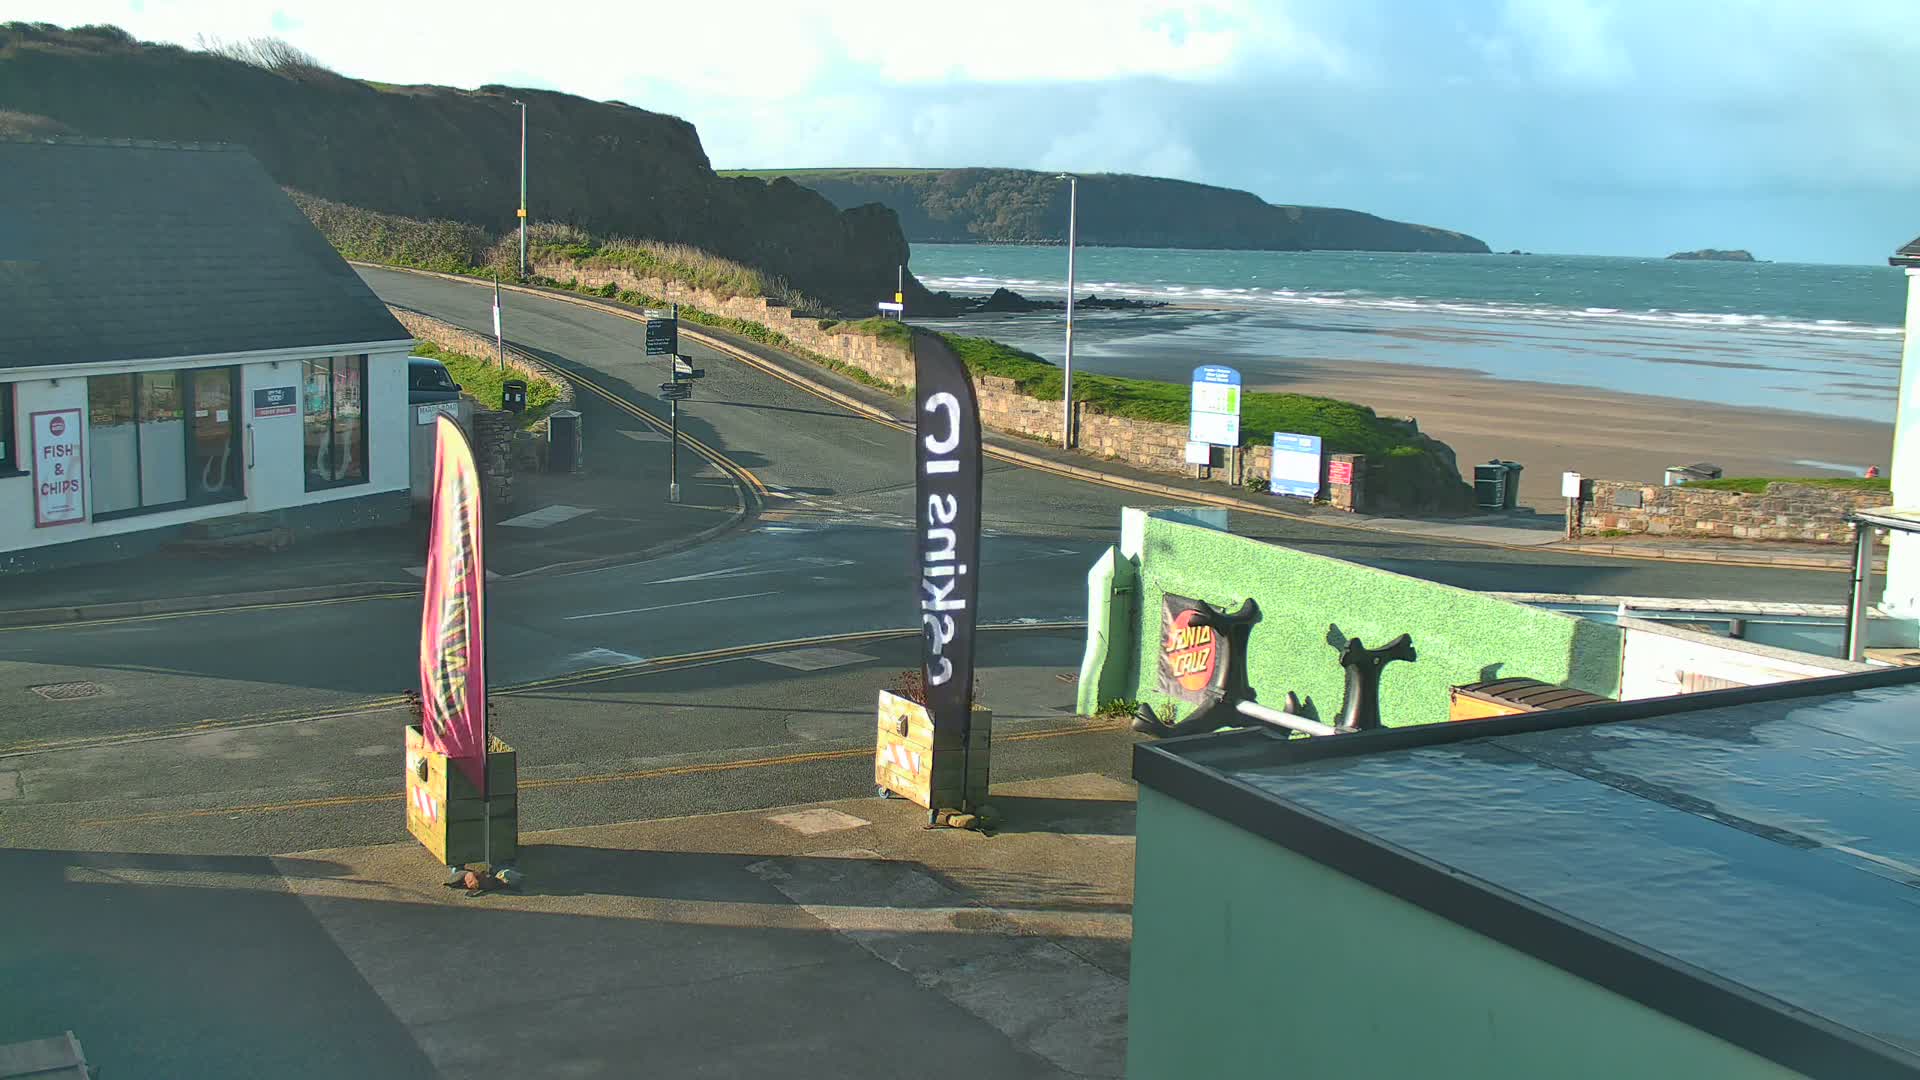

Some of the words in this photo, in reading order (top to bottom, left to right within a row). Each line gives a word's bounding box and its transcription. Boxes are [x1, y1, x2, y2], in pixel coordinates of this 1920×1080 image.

[43, 444, 74, 459] FISH
[54, 462, 65, 476] &
[41, 479, 80, 496] CHIPS
[1166, 625, 1211, 652] SANTA
[1173, 647, 1211, 677] CRUZ
